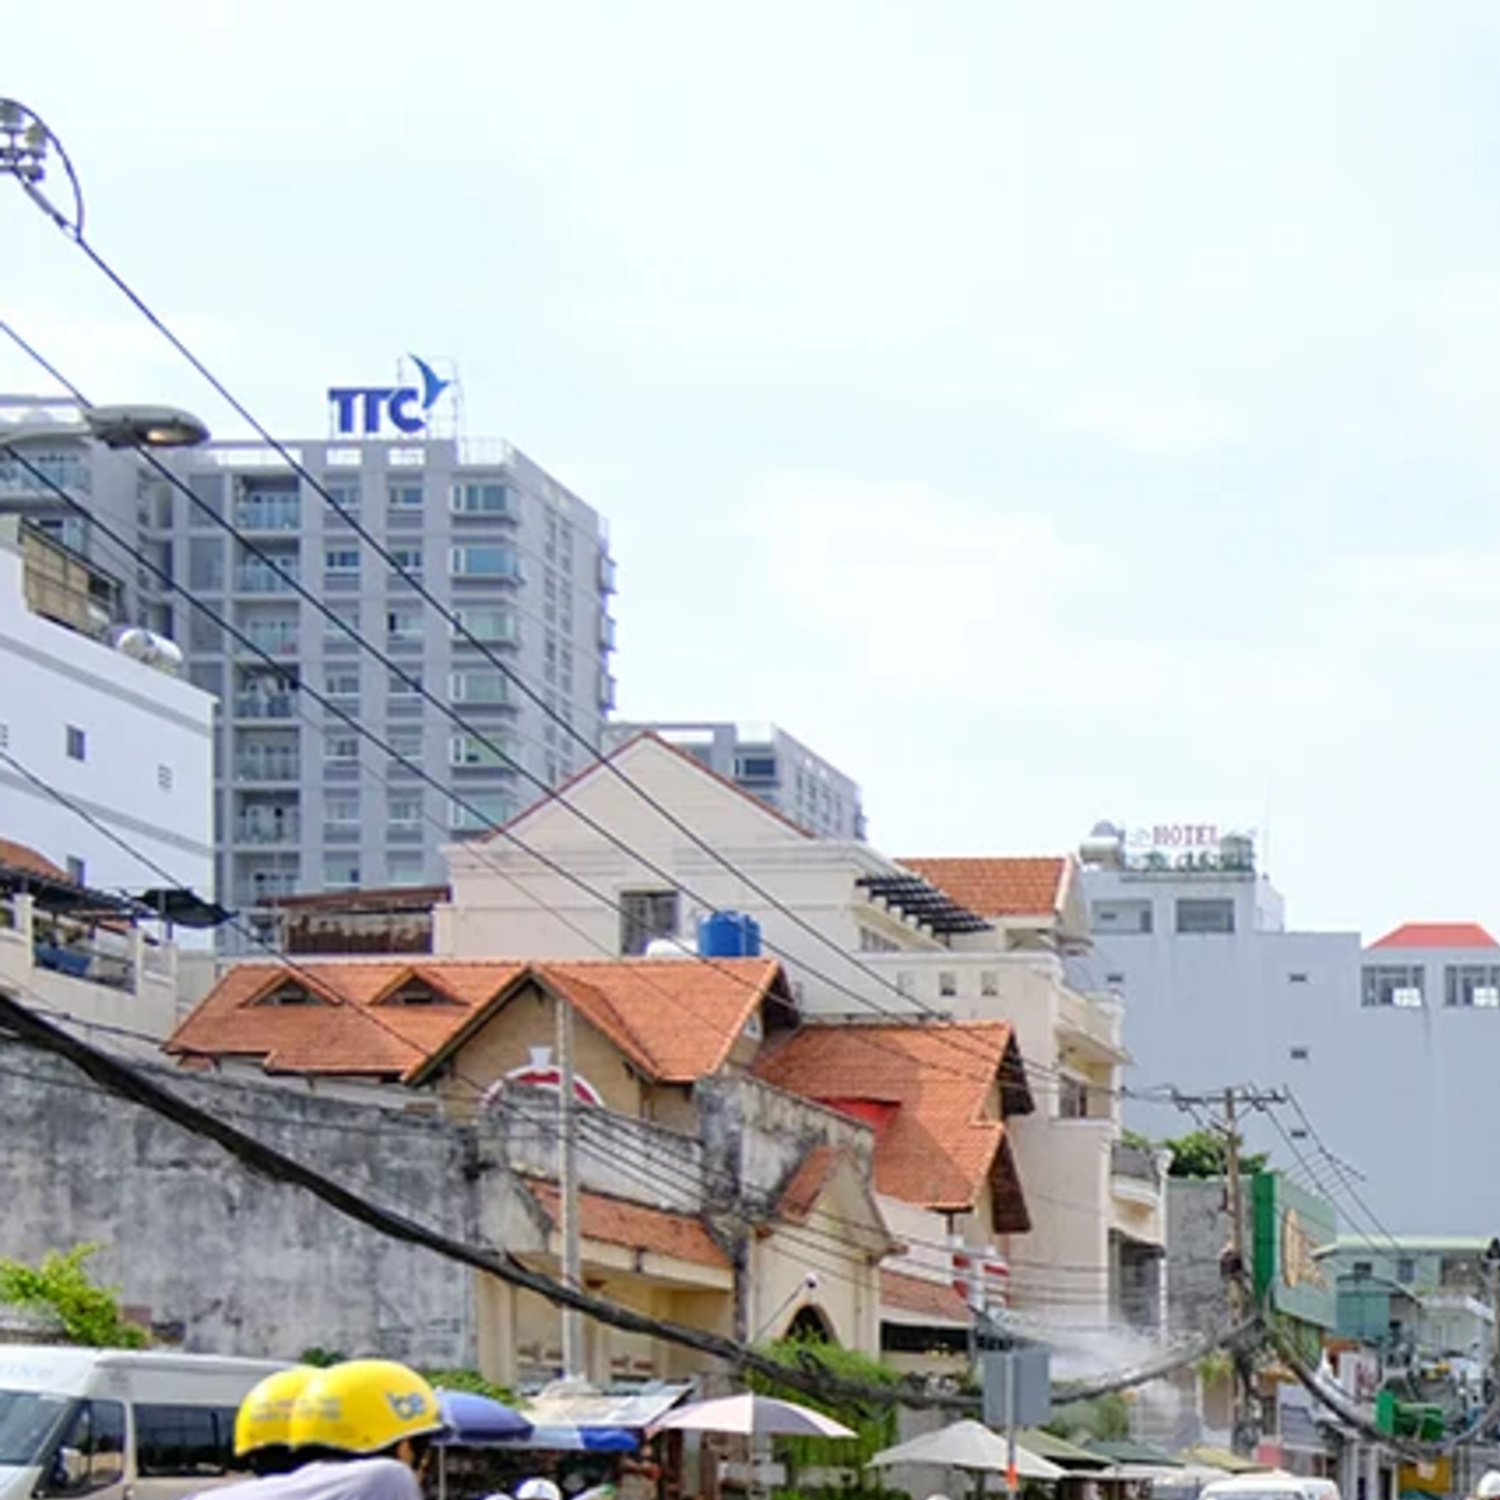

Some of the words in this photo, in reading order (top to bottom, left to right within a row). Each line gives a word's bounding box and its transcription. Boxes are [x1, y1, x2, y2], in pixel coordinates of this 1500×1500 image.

[327, 386, 426, 433] TTC
[1153, 825, 1218, 846] HOTEL
[384, 1391, 425, 1420] be
